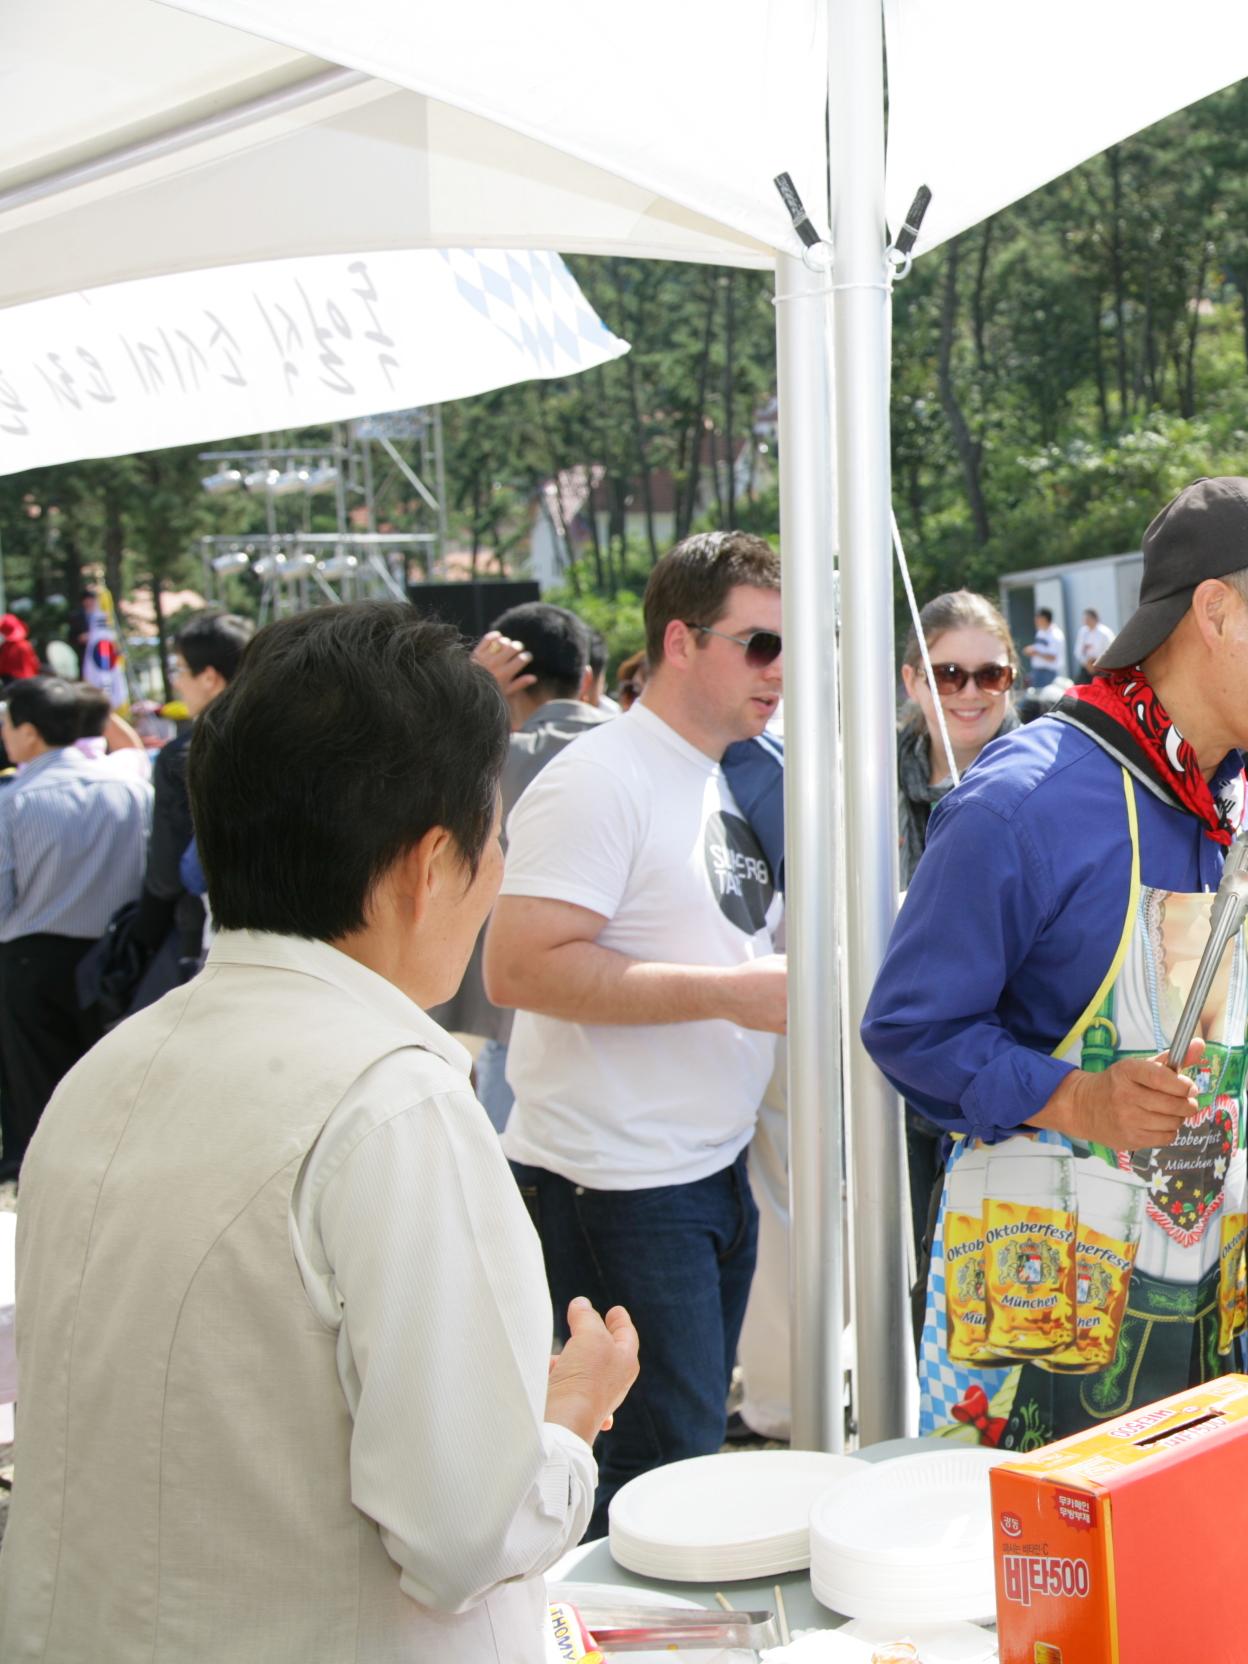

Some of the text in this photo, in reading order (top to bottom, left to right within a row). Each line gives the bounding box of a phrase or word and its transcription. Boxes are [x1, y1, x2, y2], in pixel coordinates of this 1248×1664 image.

[986, 1222, 1075, 1244] Oktoberfest
[1001, 1294, 1058, 1309] München
[1003, 1554, 1090, 1607] 비타500
[550, 1607, 576, 1661] THOMY
